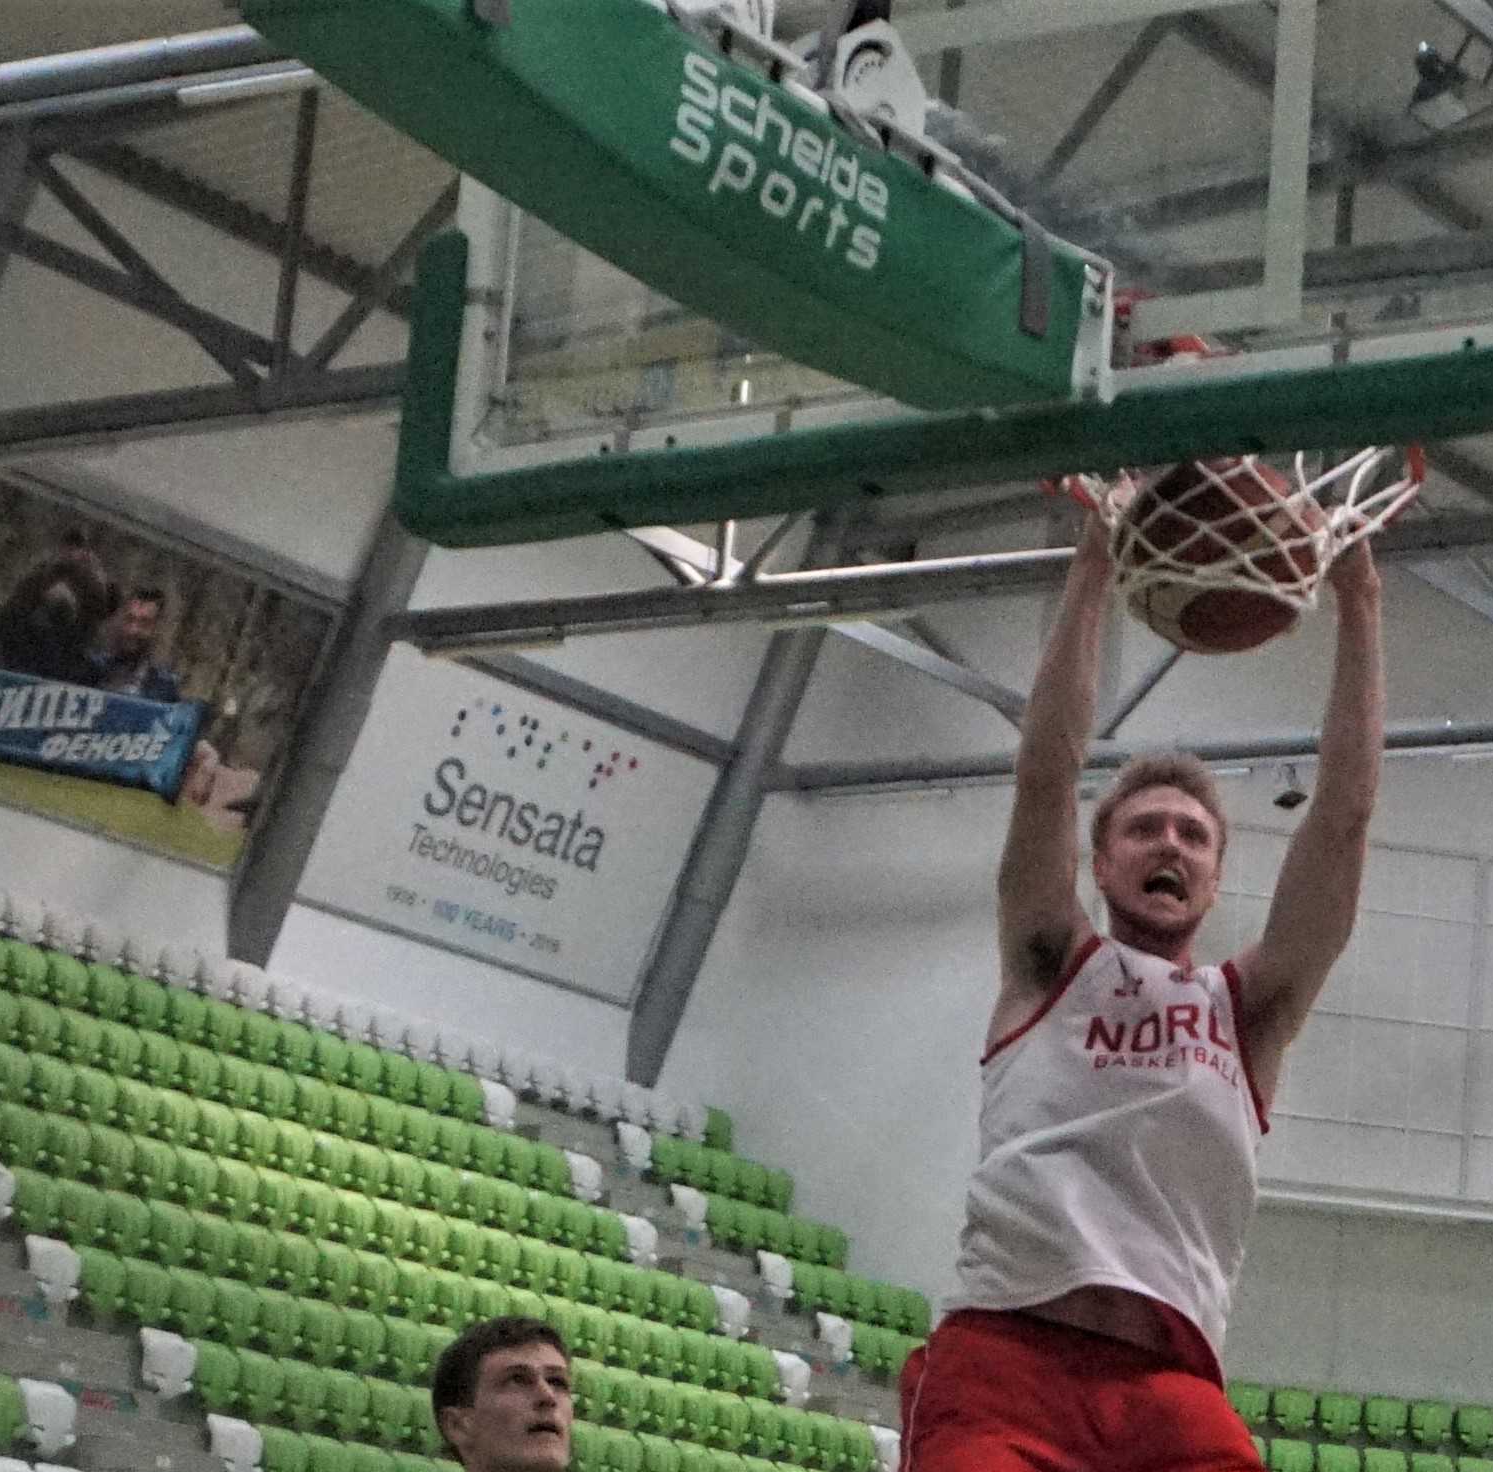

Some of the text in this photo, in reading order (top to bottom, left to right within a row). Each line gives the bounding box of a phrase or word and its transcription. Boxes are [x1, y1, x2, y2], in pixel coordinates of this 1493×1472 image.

[41, 732, 171, 762] ФЕНОВЕ
[423, 756, 606, 873] Sensata
[407, 822, 559, 901] Technologies
